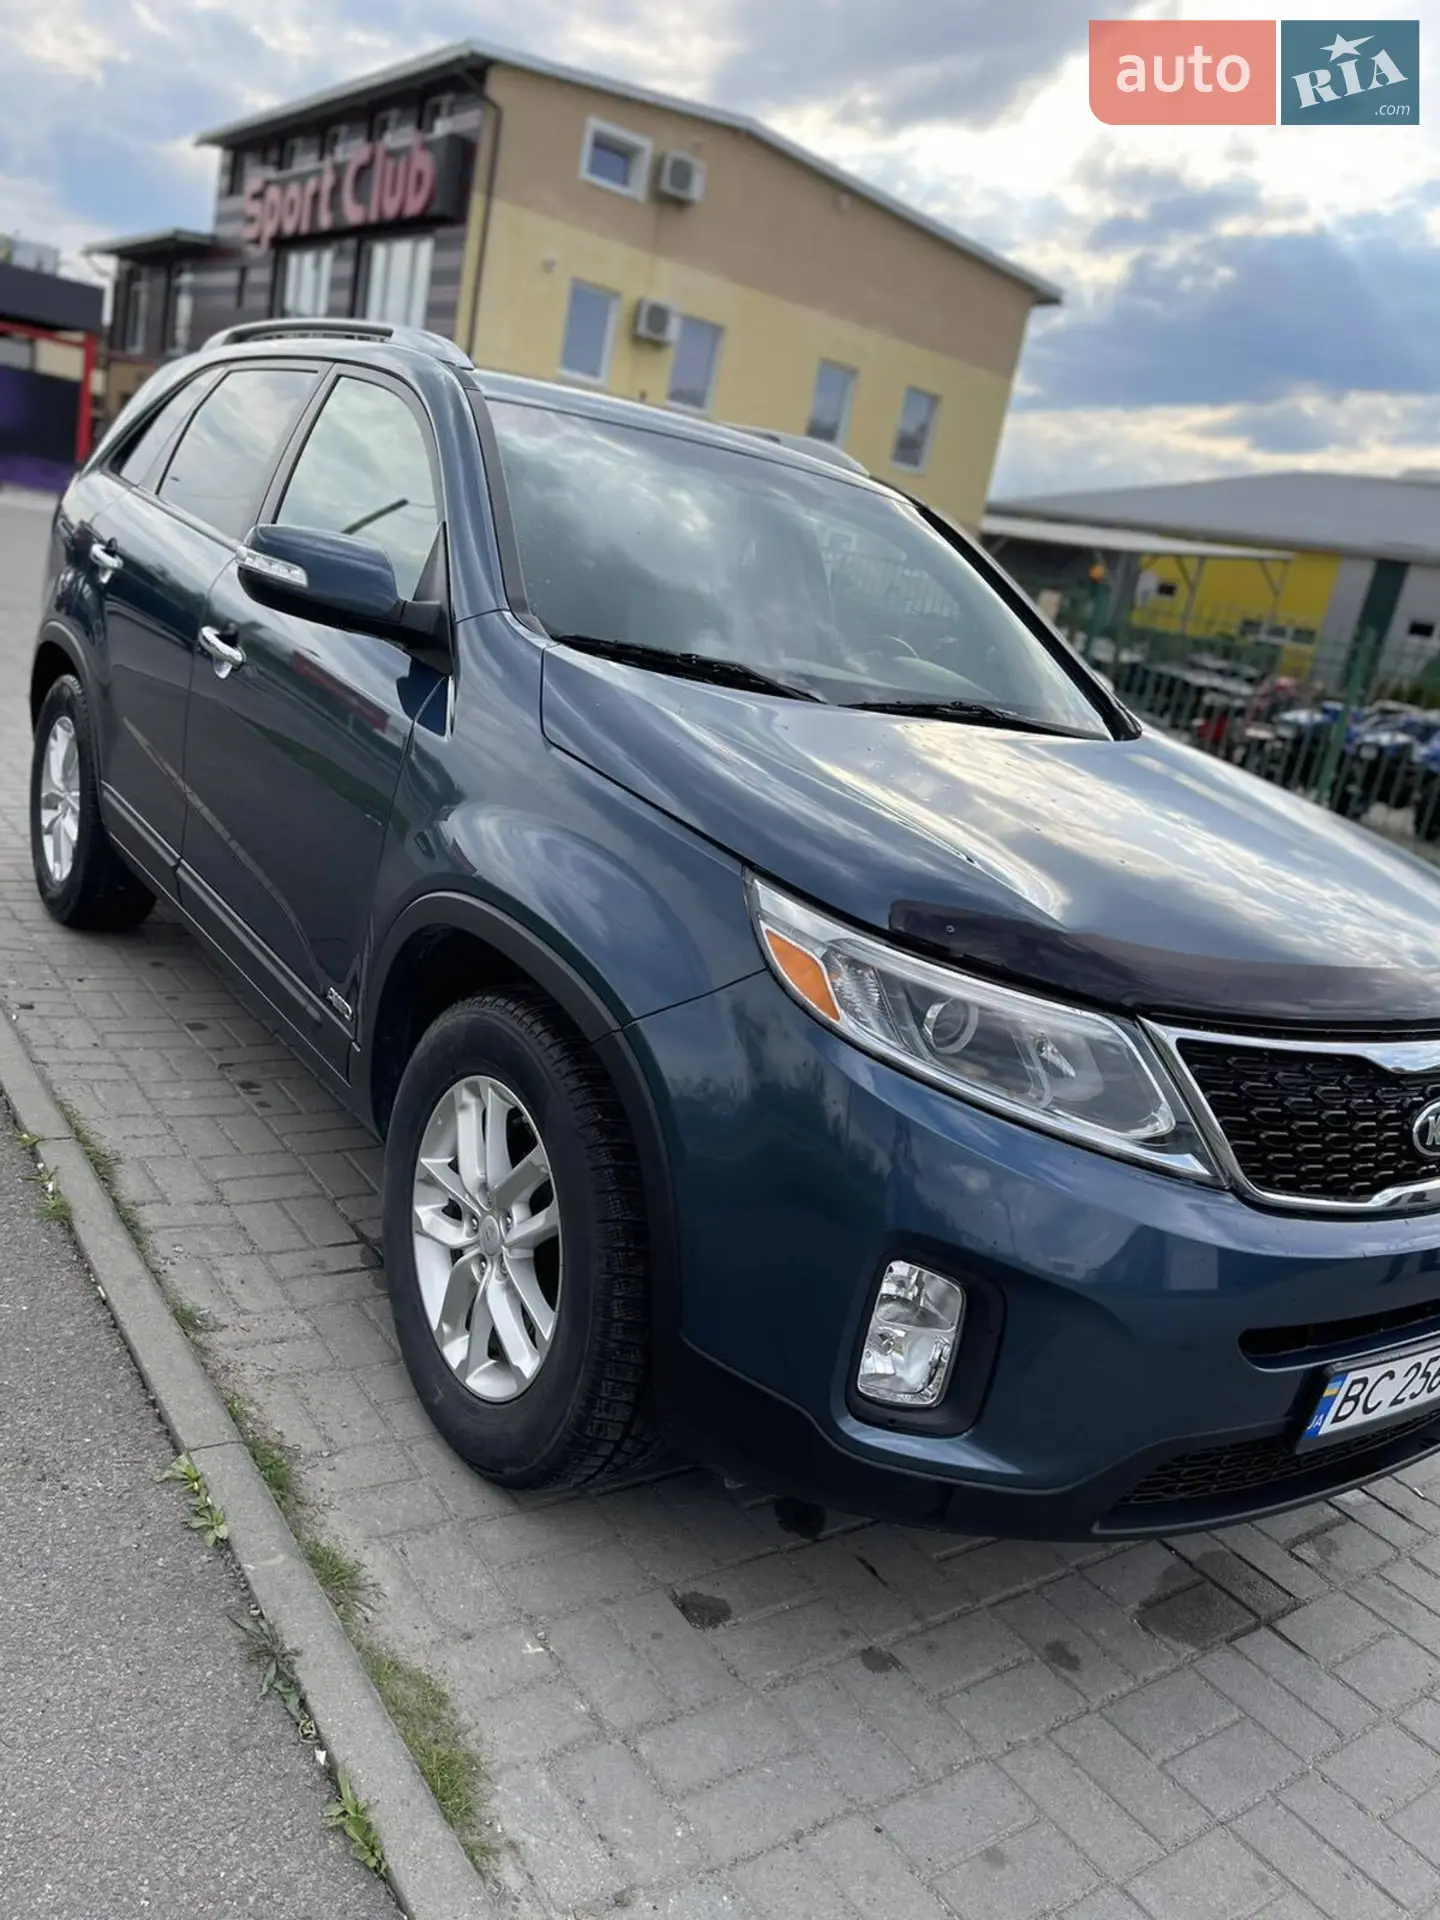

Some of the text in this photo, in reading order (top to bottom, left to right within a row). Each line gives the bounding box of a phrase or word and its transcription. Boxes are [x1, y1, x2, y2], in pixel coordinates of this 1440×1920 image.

[242, 131, 435, 256] Sport Club
[1330, 1369, 1395, 1425] BC
